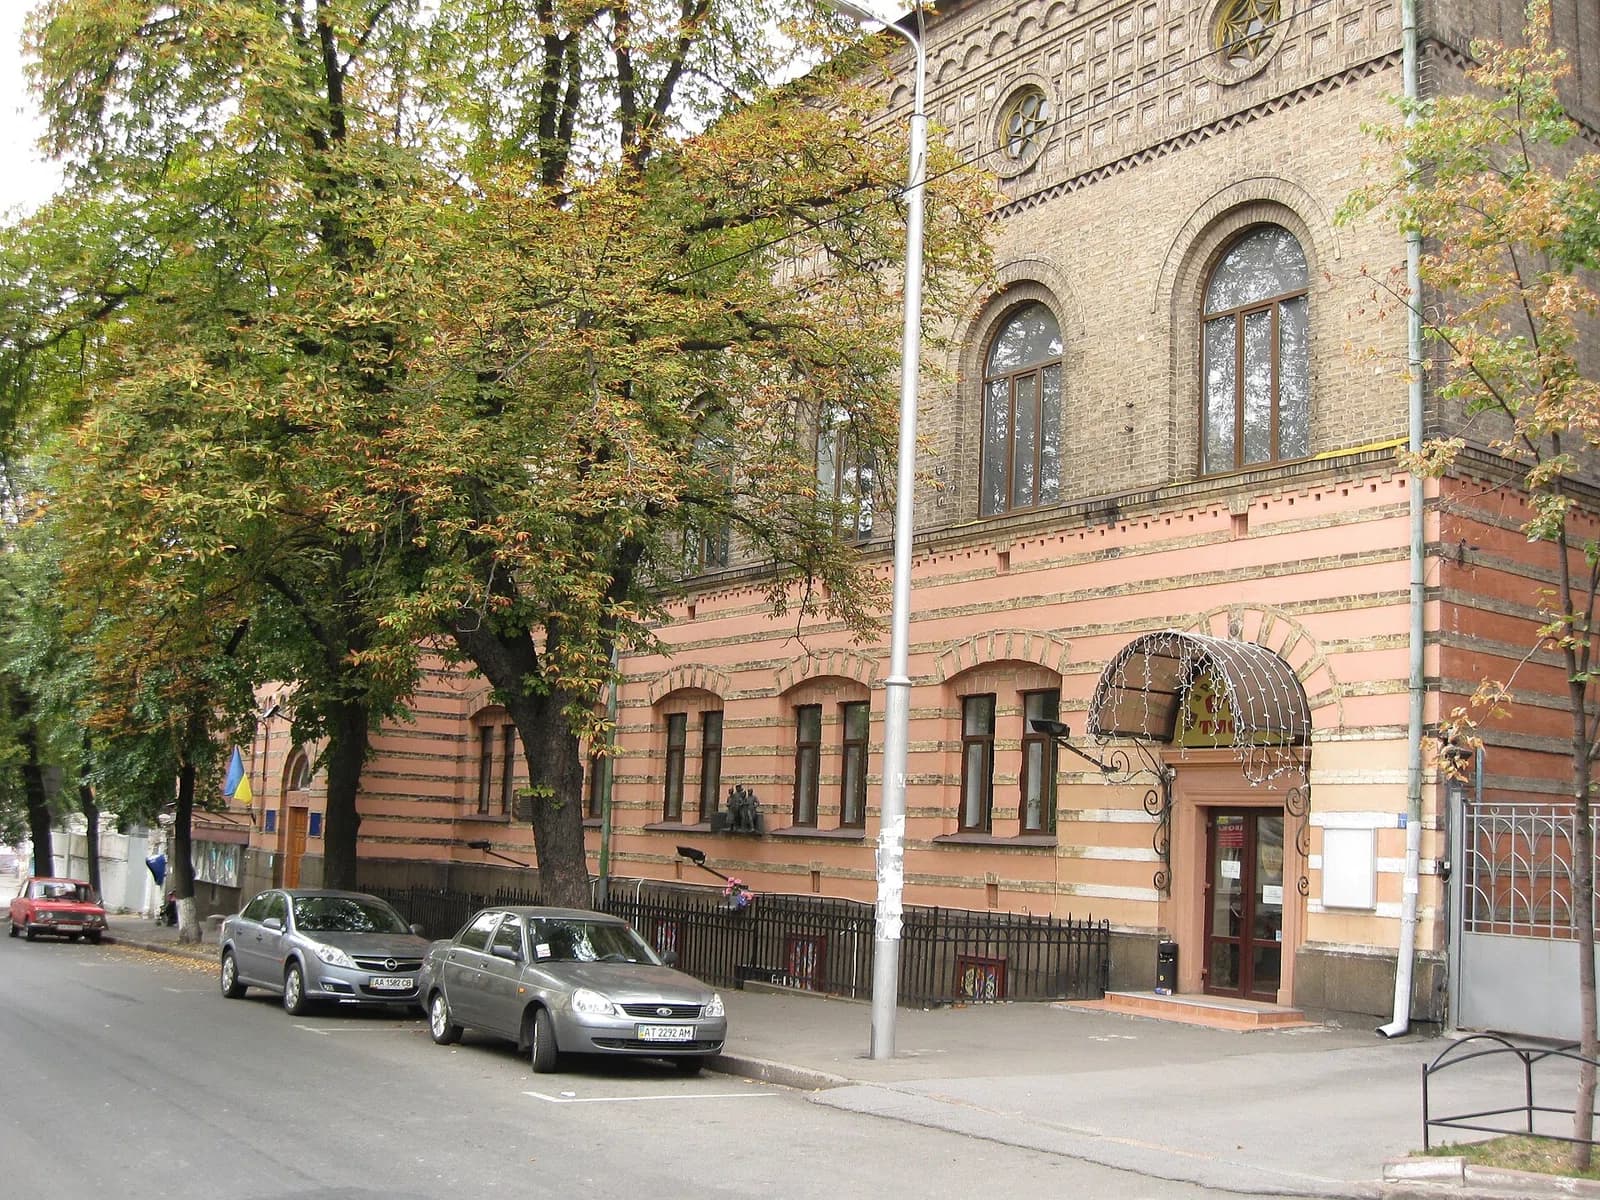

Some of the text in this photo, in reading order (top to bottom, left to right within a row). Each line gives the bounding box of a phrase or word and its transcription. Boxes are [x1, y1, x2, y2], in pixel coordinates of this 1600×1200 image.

[375, 978, 384, 986] AA
[645, 1027, 691, 1038] AT 2292 AM
